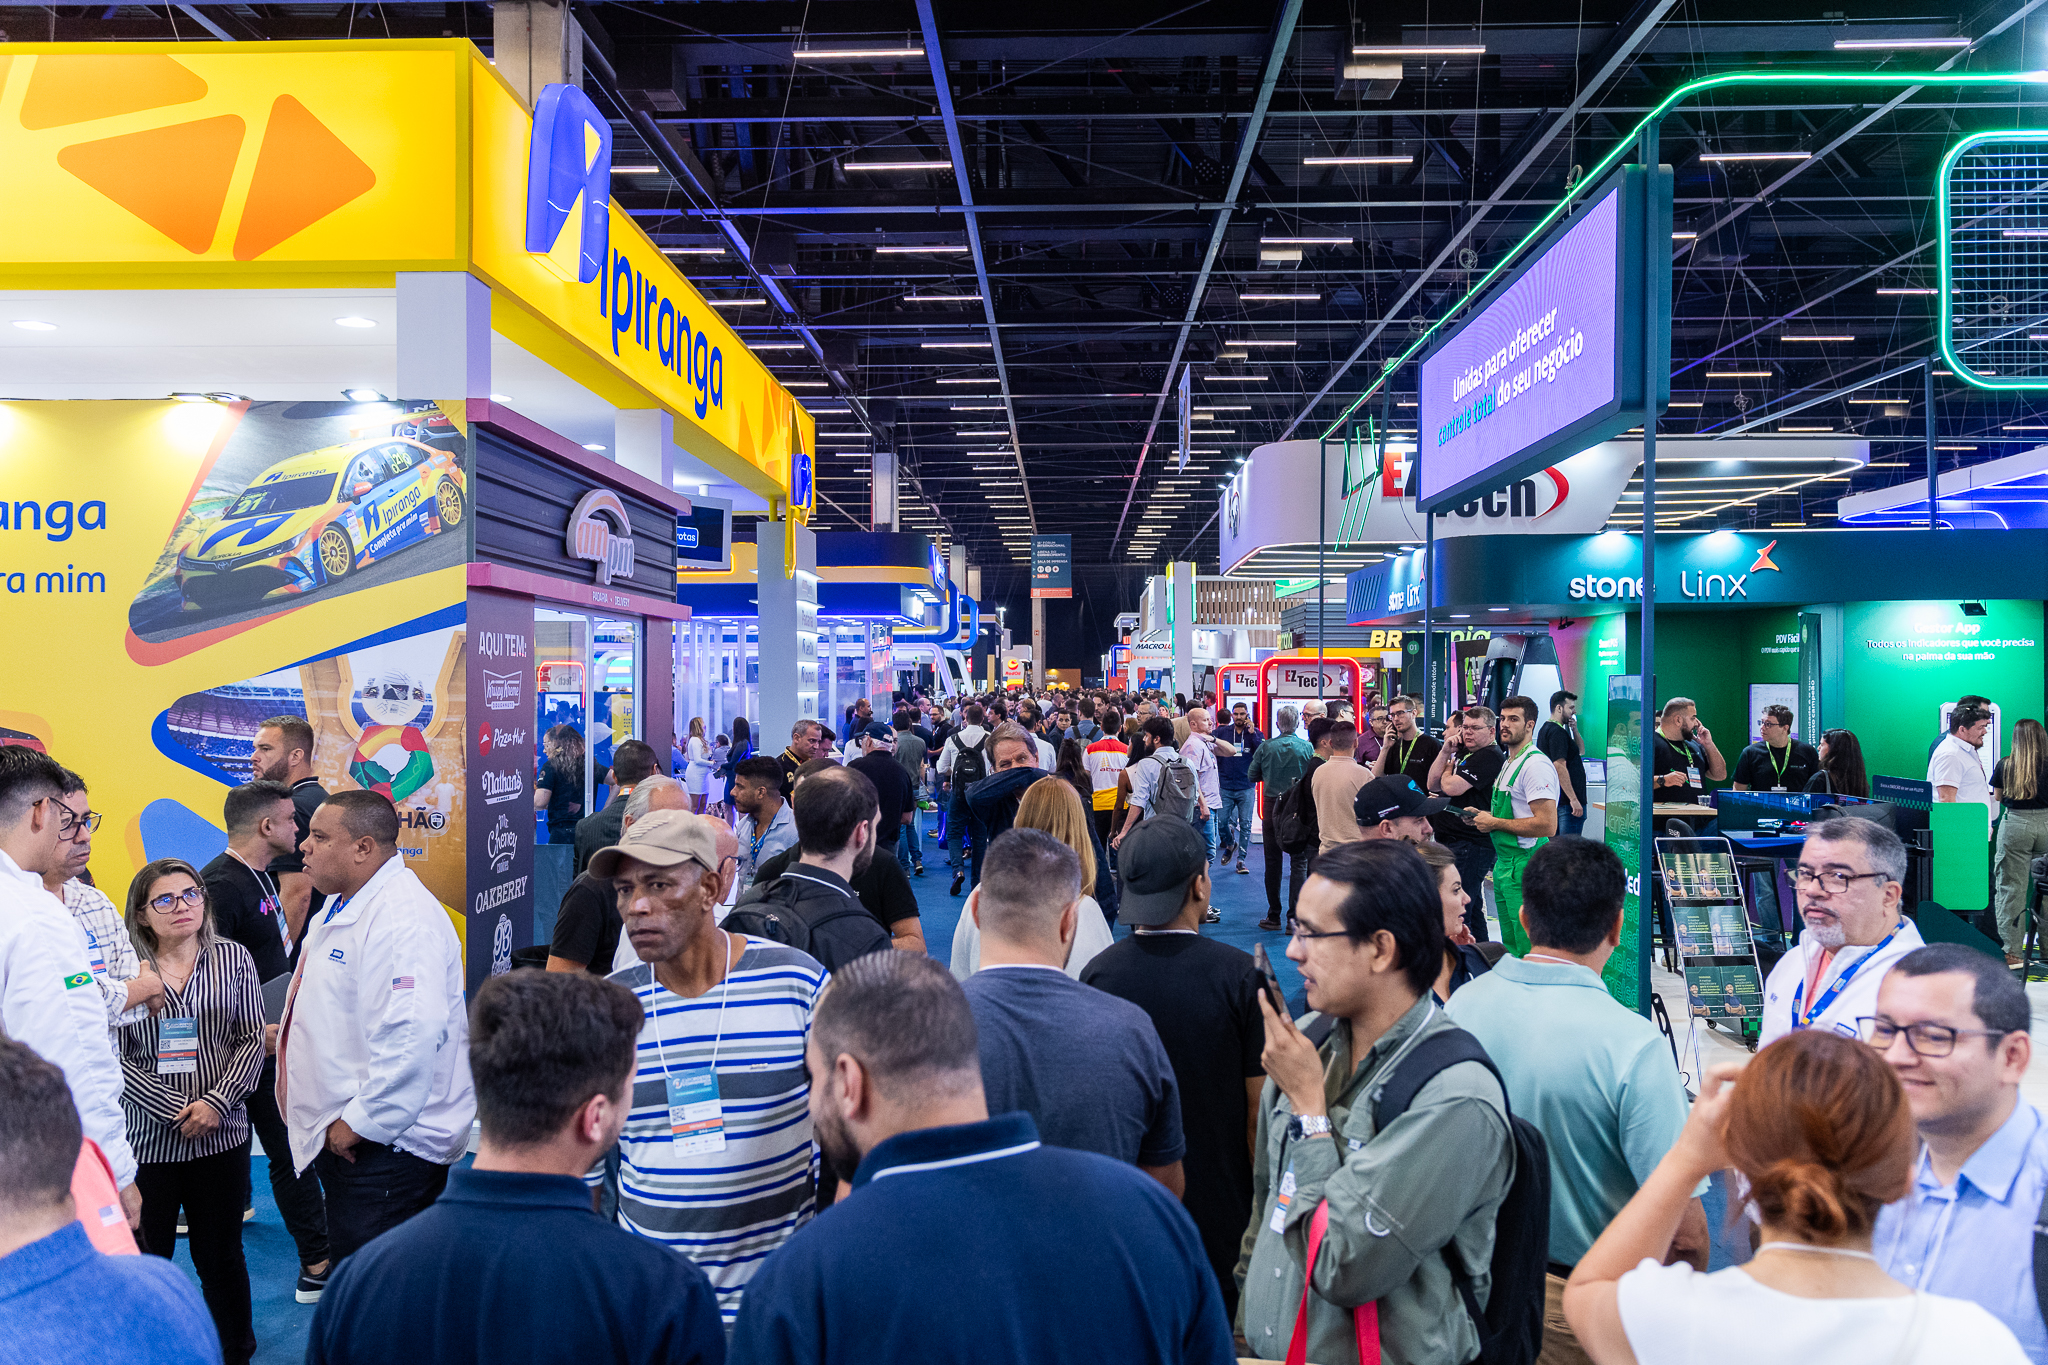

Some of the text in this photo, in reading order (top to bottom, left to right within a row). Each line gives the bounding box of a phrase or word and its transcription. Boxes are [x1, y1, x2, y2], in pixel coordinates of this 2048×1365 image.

[600, 212, 723, 421] Ipiranga
[1453, 307, 1558, 403] Unidas para oferecer
[1438, 326, 1584, 447] controle total do seu negócio
[282, 469, 327, 481] Ipiranga
[231, 497, 264, 516] 21
[382, 485, 422, 527] Ipiranga
[369, 526, 397, 554] Completa
[397, 522, 407, 538] pra
[406, 511, 418, 531] mim
[35, 563, 106, 593] mim
[592, 591, 630, 607] PADARIA DELIVERY
[1775, 633, 1800, 644] PDV Fácil
[1913, 622, 1981, 635] Gestor App
[479, 631, 527, 660] AQUI TEM:
[1866, 637, 2035, 650] Todos os indicadores que você precisa
[1902, 652, 1996, 662] na palma da sua mão
[1285, 669, 1297, 682] EZ
[487, 680, 520, 700] Krispy Kreme
[492, 727, 527, 749] Pizza Hut
[482, 768, 523, 797] Nathan's
[487, 822, 518, 861] Cheney
[475, 875, 528, 914] OAKBERRY
